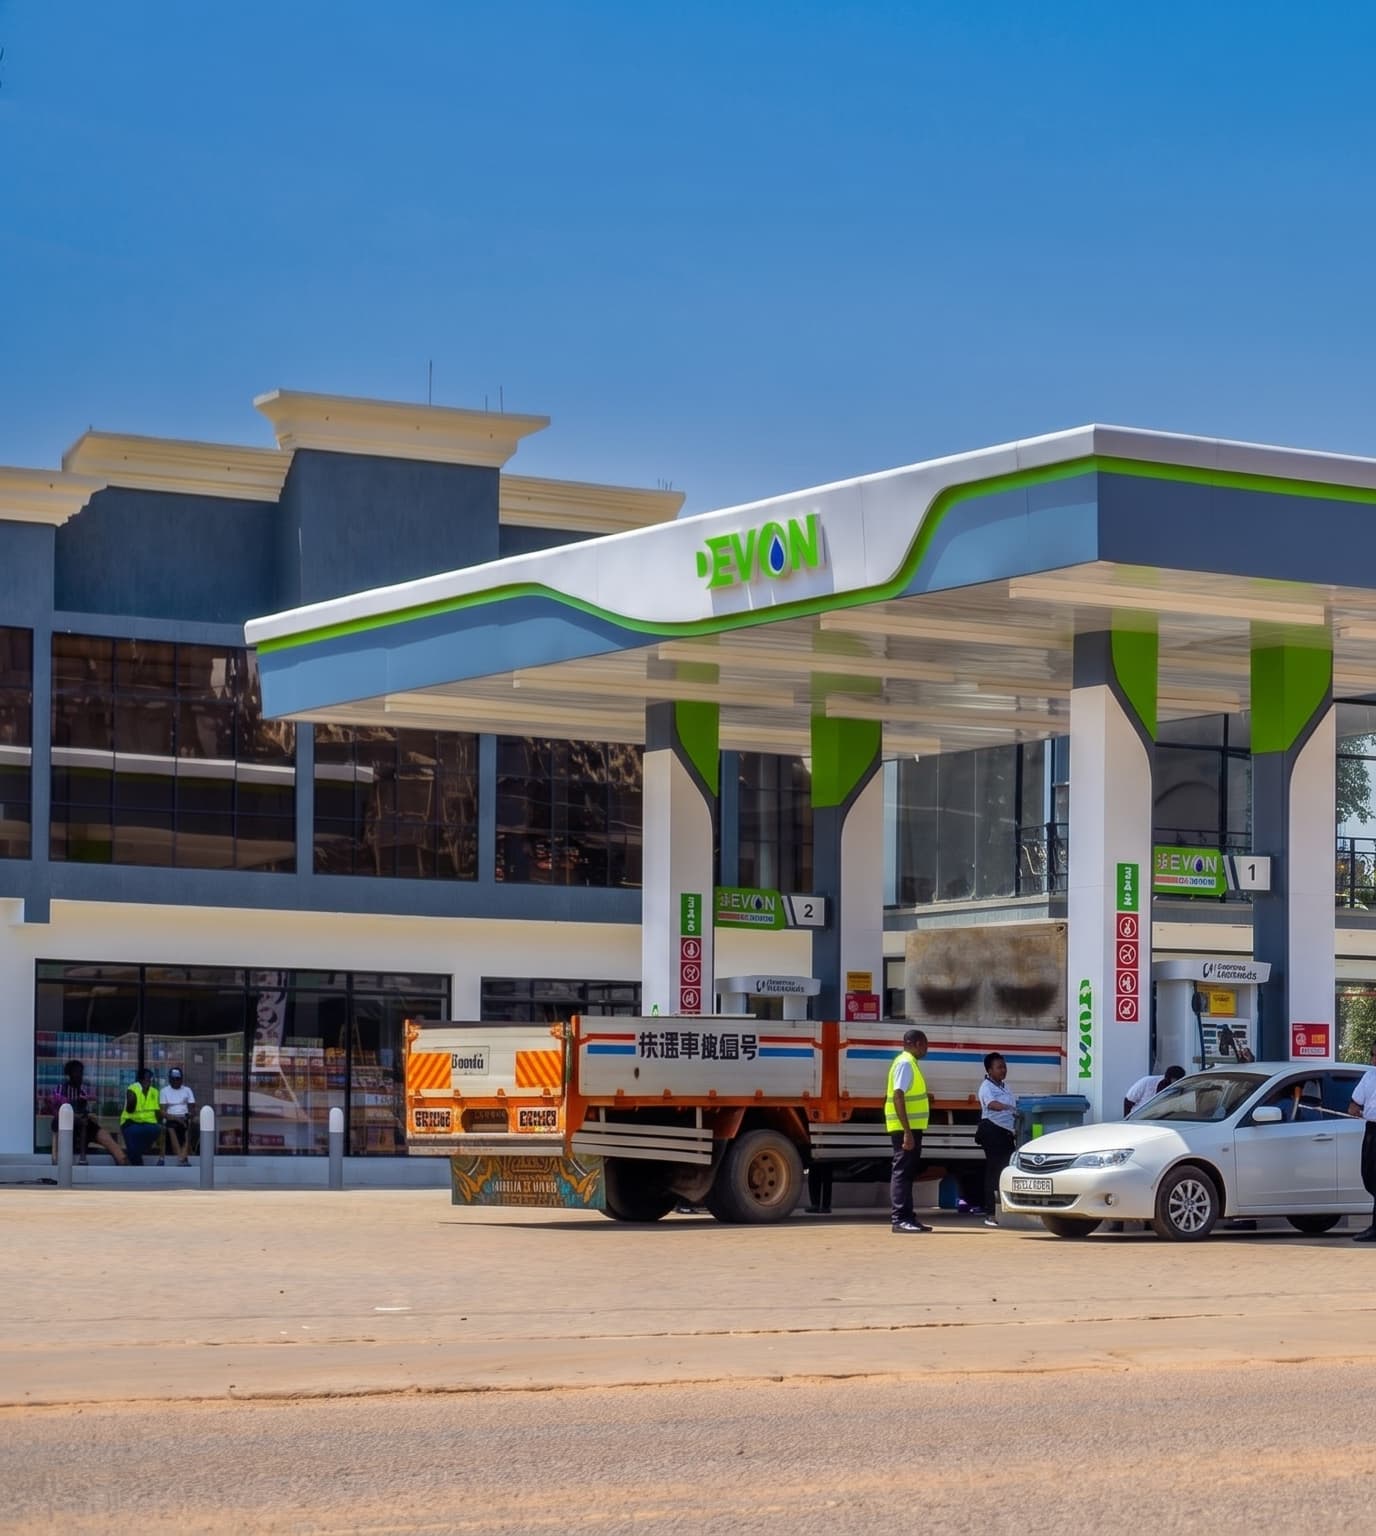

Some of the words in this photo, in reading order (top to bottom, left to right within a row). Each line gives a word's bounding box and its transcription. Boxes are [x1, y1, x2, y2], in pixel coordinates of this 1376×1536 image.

[695, 512, 819, 589] DEVON
[1248, 863, 1256, 881] 1
[803, 903, 814, 918] 2
